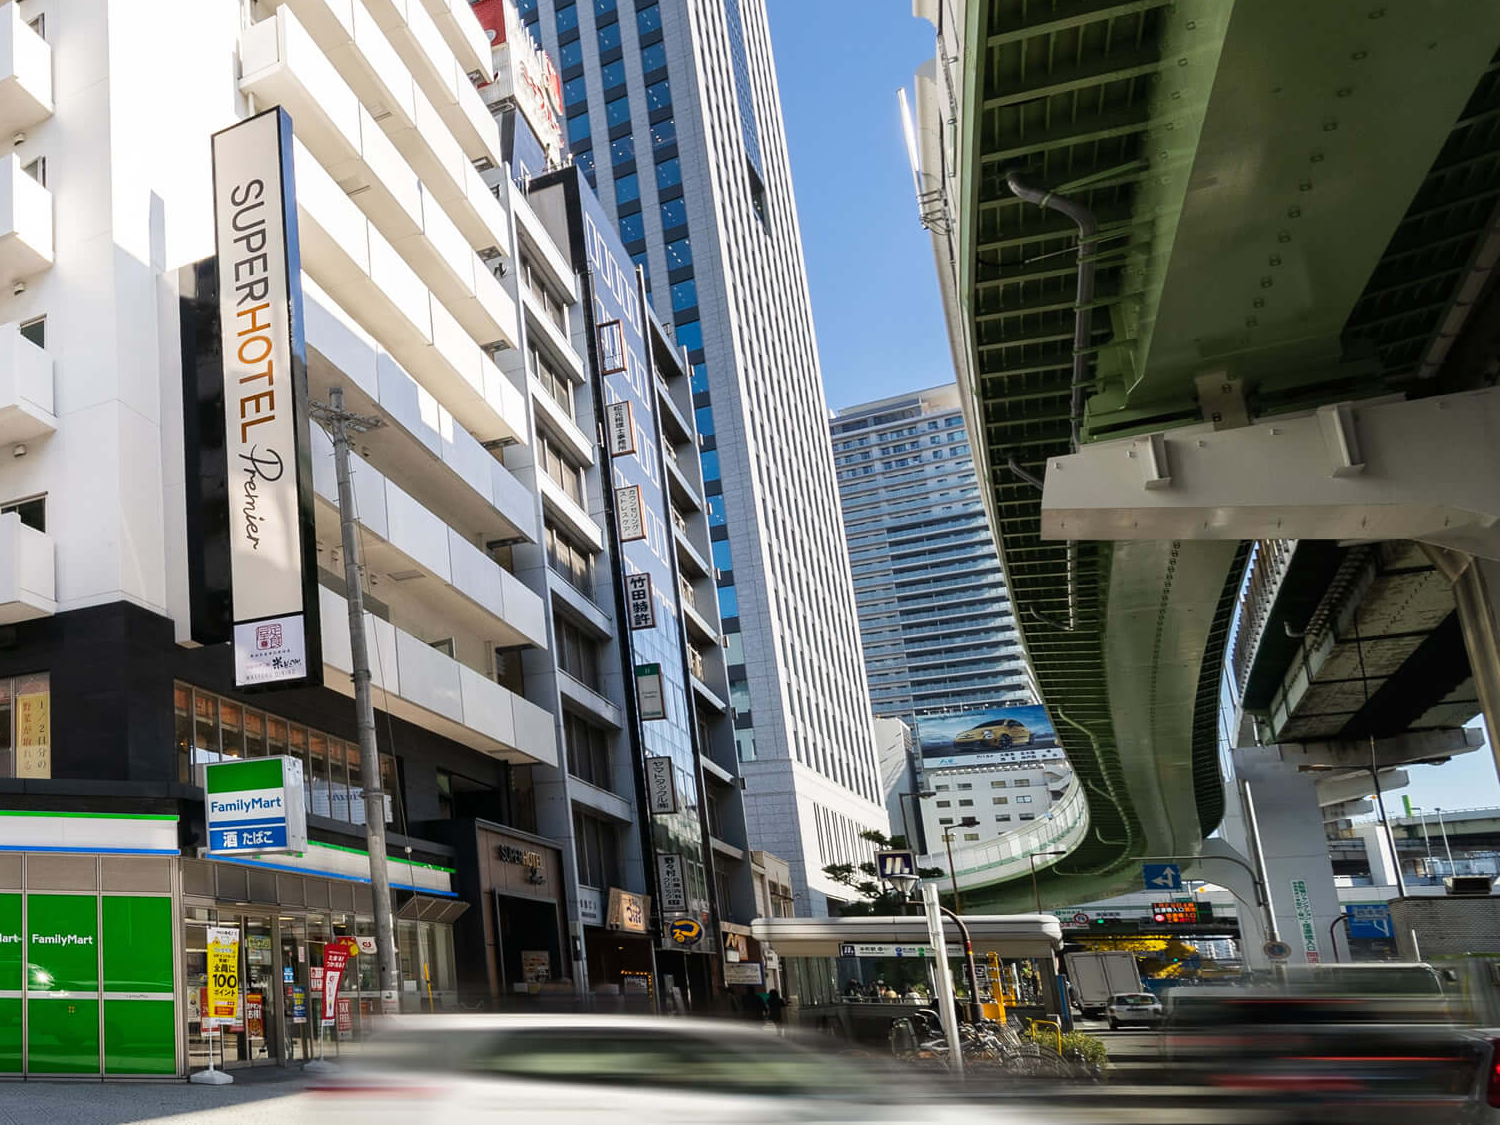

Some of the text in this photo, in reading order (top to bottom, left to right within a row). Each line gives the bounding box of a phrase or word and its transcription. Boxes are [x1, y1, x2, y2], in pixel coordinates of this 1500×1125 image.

[231, 178, 276, 444] SUPERHOTEL
[239, 444, 284, 551] Premier
[630, 577, 650, 625] 竹田特許
[211, 796, 282, 813] FamilyMart
[223, 831, 274, 848] 酒 たばこ
[32, 933, 93, 946] FamilyMart
[213, 964, 236, 973] 全員に
[212, 974, 238, 989] 100
[213, 989, 236, 997] ポイント
